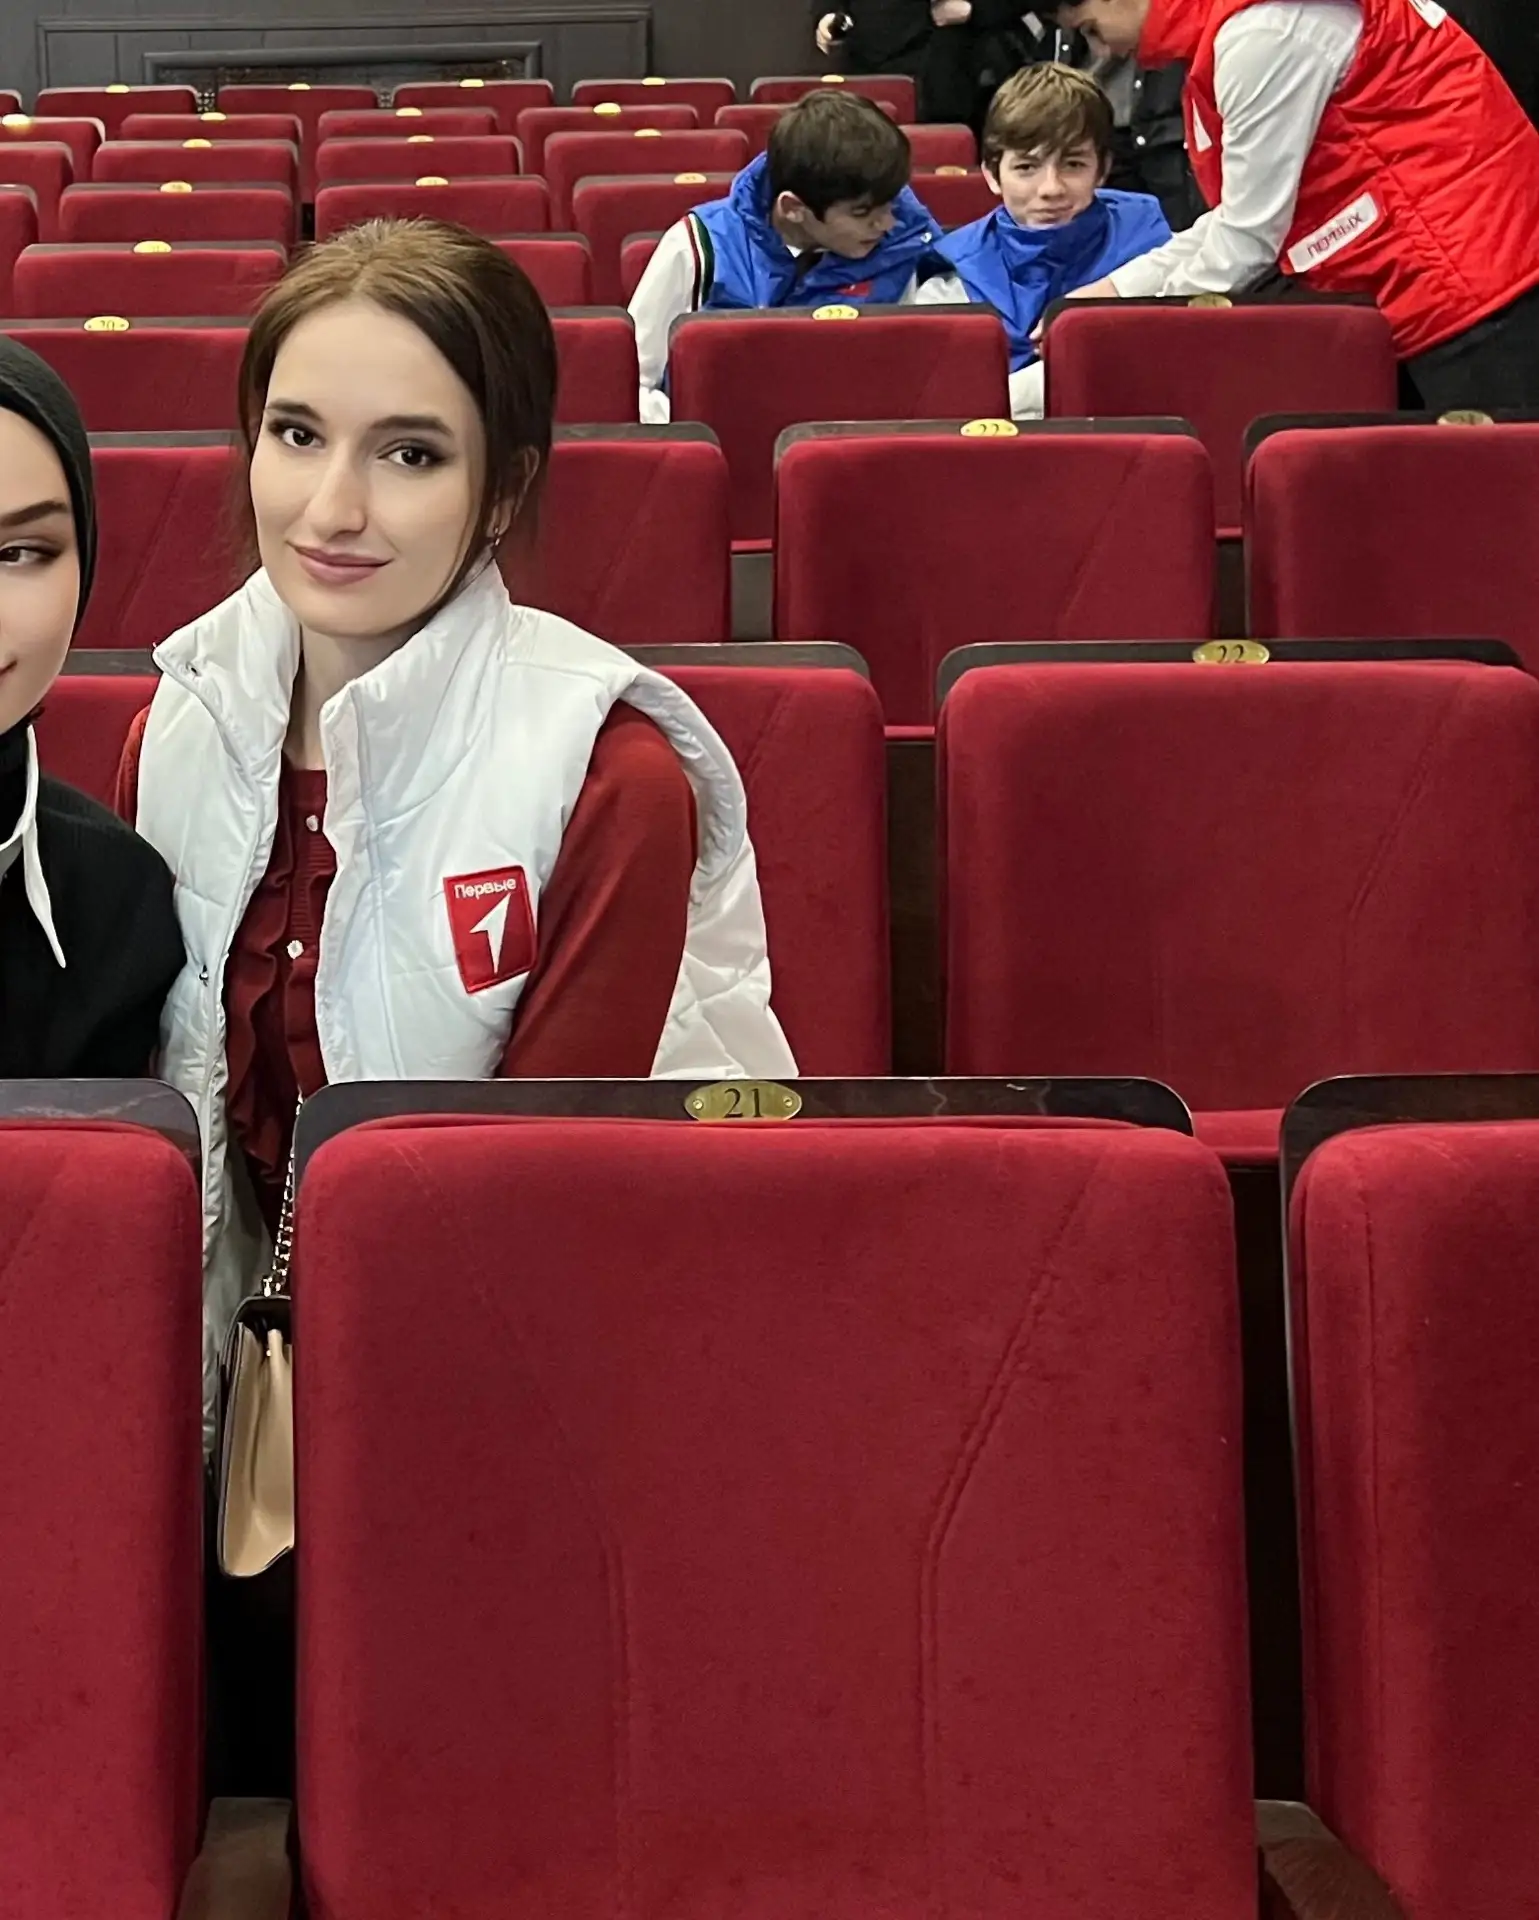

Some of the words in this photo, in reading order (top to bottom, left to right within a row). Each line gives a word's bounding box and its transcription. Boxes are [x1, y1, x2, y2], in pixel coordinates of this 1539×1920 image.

[1217, 644, 1246, 664] 22
[454, 878, 517, 900] Первые
[723, 1088, 763, 1118] 21
